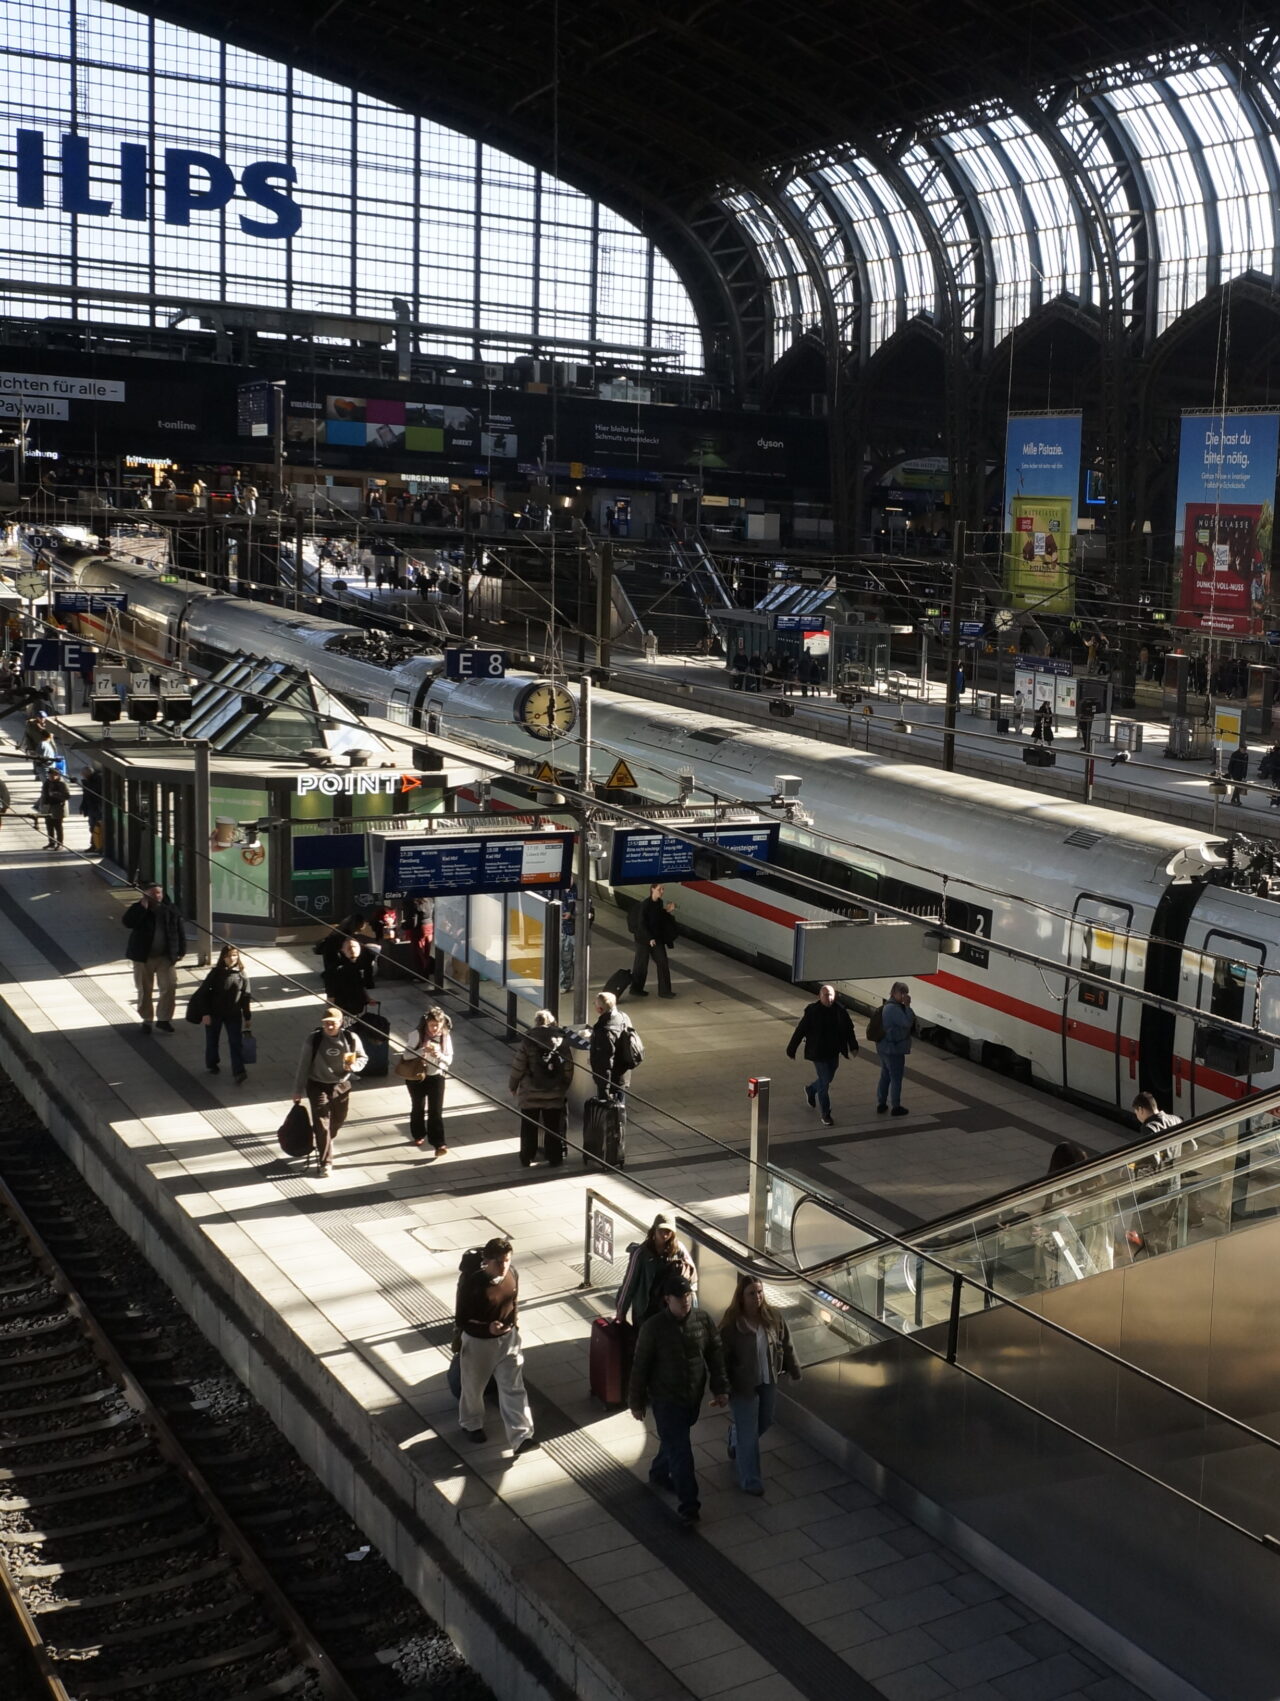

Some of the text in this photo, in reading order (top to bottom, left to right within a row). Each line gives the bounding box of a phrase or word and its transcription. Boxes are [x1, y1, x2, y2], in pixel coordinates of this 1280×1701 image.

[17, 128, 302, 239] ILIPS
[53, 380, 76, 394] für
[79, 383, 107, 396] alle
[157, 419, 197, 431] t-online
[756, 436, 784, 449] dyson
[1205, 429, 1251, 445] Die hast du
[1226, 451, 1250, 469] nötig.
[401, 474, 449, 483] BURGER KING
[1198, 519, 1249, 529] NUSKLASSE
[34, 537, 42, 548] D
[864, 581, 875, 590] 12
[27, 643, 81, 668] 7 E
[458, 653, 503, 676] E 8
[98, 678, 181, 690] r7 v7 t7
[297, 773, 401, 796] POINT
[975, 914, 985, 936] 2
